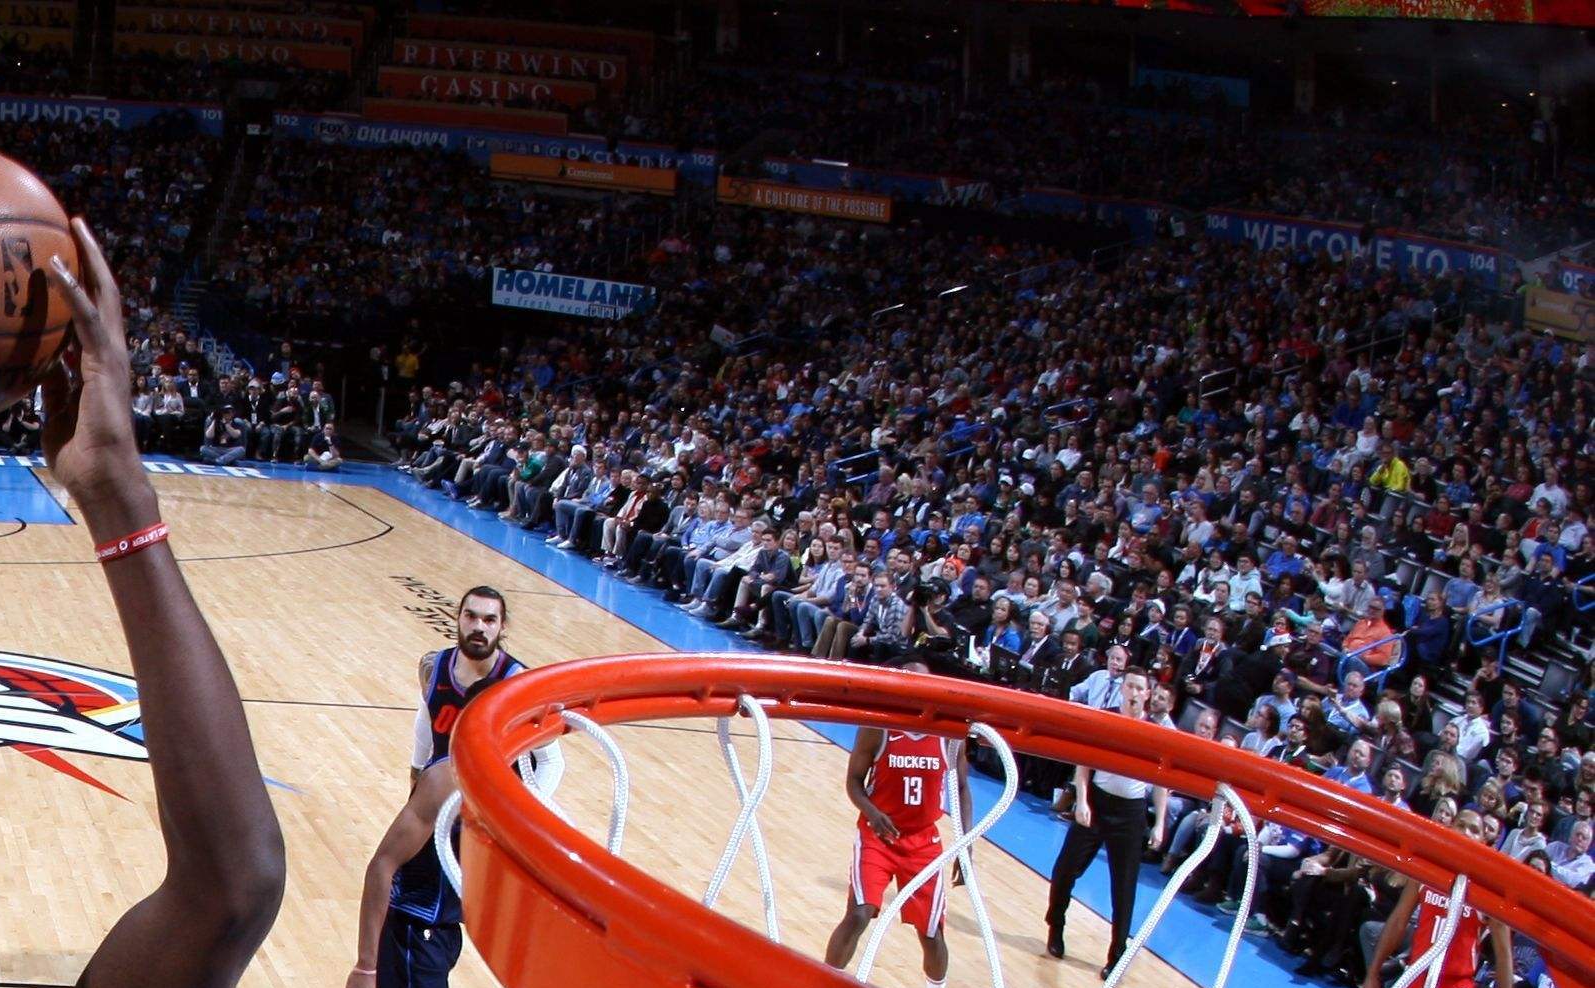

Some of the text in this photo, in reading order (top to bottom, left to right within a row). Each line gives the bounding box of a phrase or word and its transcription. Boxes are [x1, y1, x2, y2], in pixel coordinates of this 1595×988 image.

[150, 13, 328, 38] RIVERWIND
[174, 40, 291, 63] CASINO
[403, 44, 619, 81] RIVERWIND
[420, 74, 552, 101] CASINO
[202, 110, 223, 121] 101
[274, 114, 300, 128] 102
[356, 126, 449, 147] OKLAHOMA
[692, 152, 715, 167] 102
[764, 189, 809, 209] CULTURE
[813, 196, 823, 210] OF
[826, 197, 841, 212] THE
[843, 199, 886, 218] POSSIBLE
[1206, 214, 1229, 231] 104
[1242, 219, 1449, 278] WELCOME TO
[1470, 251, 1495, 272] 104
[888, 752, 940, 770] ROCKETS
[902, 776, 923, 806] 13
